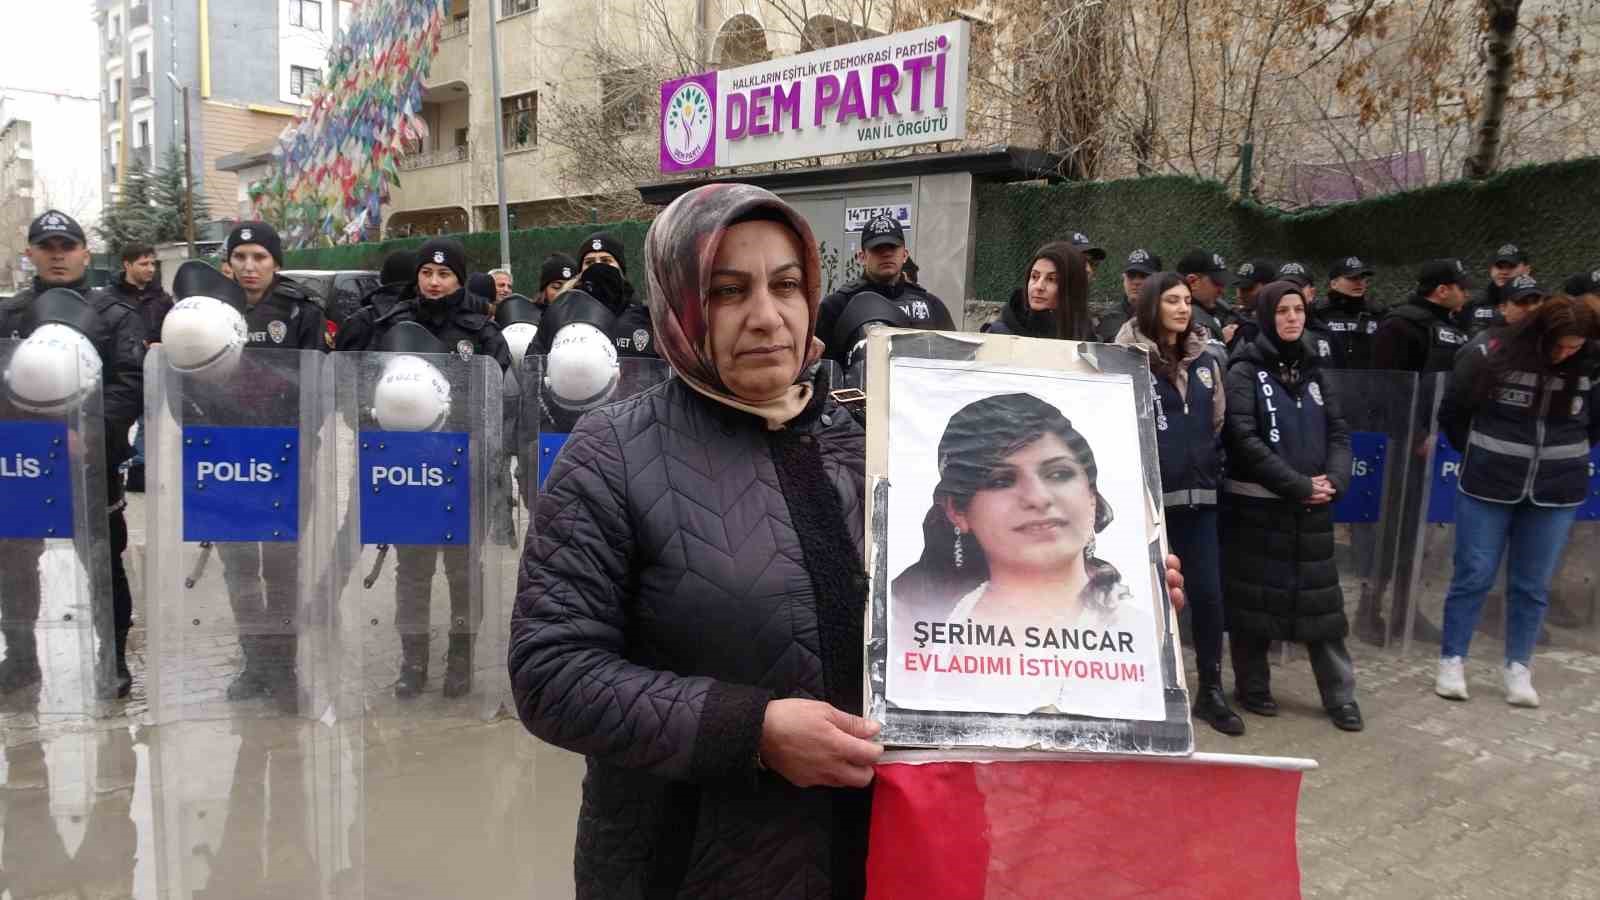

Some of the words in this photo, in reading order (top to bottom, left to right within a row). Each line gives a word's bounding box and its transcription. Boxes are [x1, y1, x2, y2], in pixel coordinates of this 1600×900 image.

[733, 71, 781, 90] HALKLARIN
[783, 62, 817, 81] EŞİTLİK
[819, 60, 832, 73] VE
[833, 46, 892, 71] DEMOKRASİ
[895, 36, 938, 59] PARTİSİ
[725, 80, 801, 140] DEM
[814, 35, 948, 126] PARTİ
[857, 125, 881, 142] VAN
[883, 121, 894, 139] İL
[896, 114, 948, 137] ÖRGÜTÜ
[1258, 371, 1280, 443] POLİS
[198, 458, 272, 482] POLİS
[372, 463, 443, 487] POLİS
[913, 618, 1016, 648] ŞERİMA
[1024, 627, 1135, 653] SANCAR
[904, 652, 1011, 675] EVLADIMI
[1019, 653, 1145, 682] İSTİYORUM!
